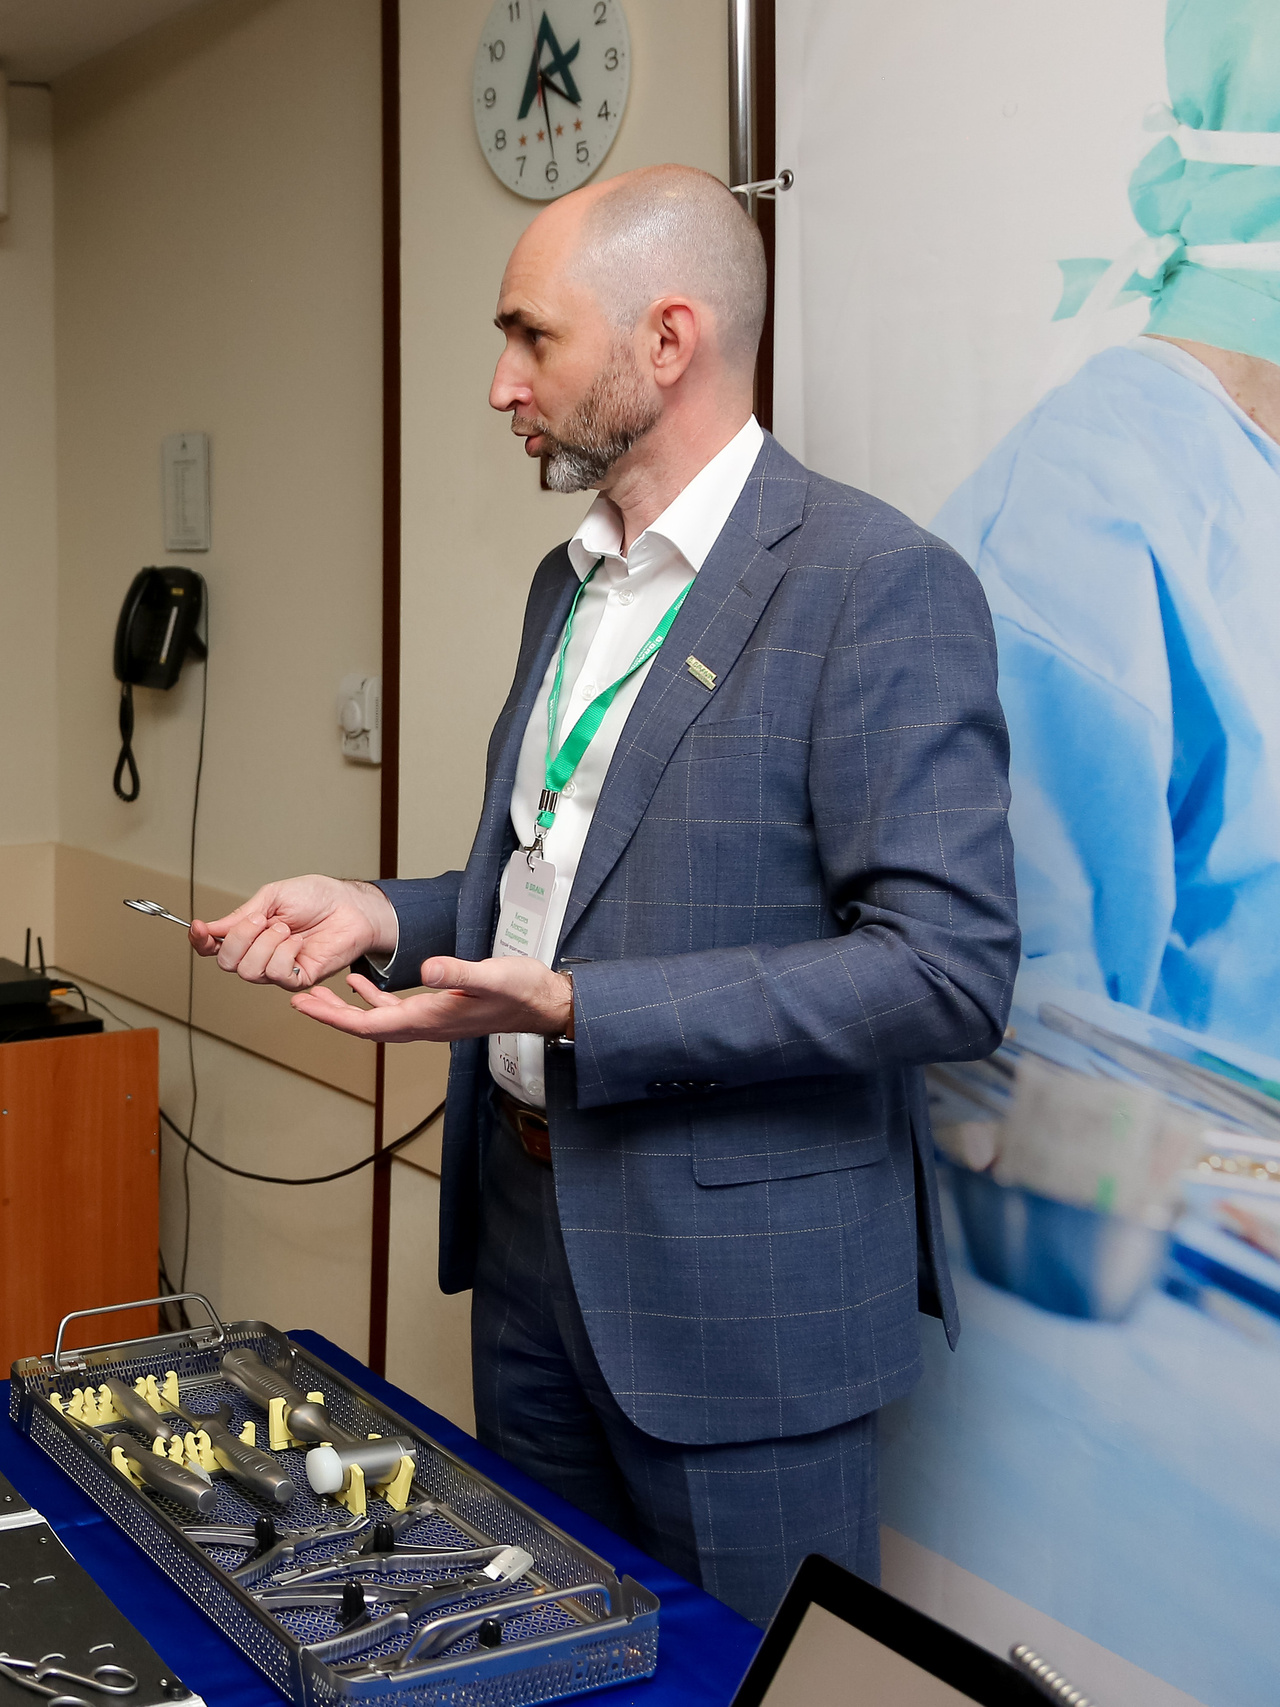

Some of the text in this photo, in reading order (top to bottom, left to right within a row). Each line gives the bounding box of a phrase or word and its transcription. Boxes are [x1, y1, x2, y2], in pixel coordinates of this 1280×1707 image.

[508, 1, 520, 23] 11
[593, 1, 607, 26] 2
[488, 39, 505, 63] 10
[604, 47, 619, 71] 3
[484, 87, 496, 109] 9
[597, 100, 611, 121] 4
[494, 129, 507, 150] 8
[576, 140, 590, 163] 5
[516, 155, 527, 178] 7
[545, 160, 559, 183] 6
